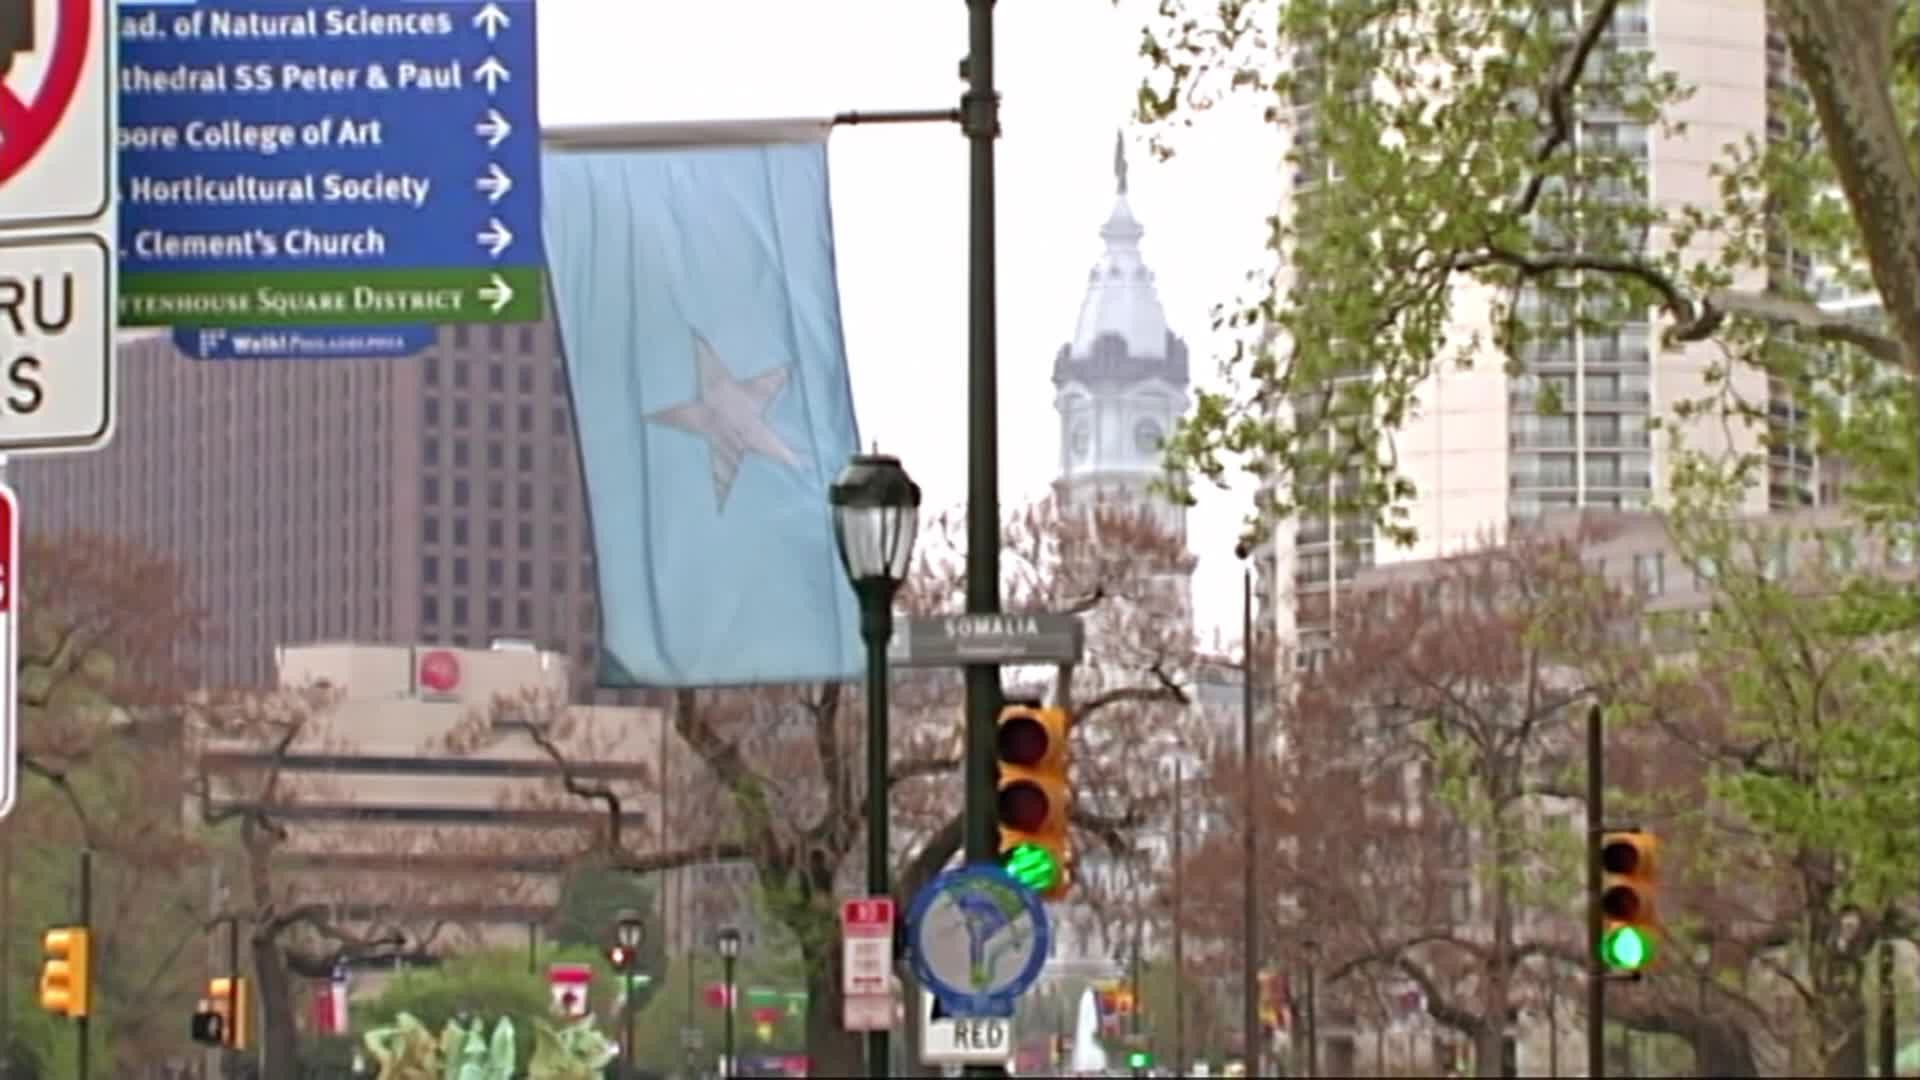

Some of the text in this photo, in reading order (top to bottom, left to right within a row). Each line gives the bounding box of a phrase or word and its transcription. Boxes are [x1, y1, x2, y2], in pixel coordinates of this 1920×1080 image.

[173, 9, 204, 37] of
[210, 9, 317, 36] Natural
[325, 8, 452, 35] Sciences
[121, 60, 461, 92] thedral SS Peter & Paul
[186, 120, 295, 154] College
[302, 118, 331, 145] of
[338, 119, 382, 145] Art
[131, 174, 314, 203] Horticultural
[323, 173, 429, 205] Society
[136, 228, 385, 257] Clement's Church
[354, 287, 463, 311] DISTRICT
[0, 355, 44, 416] S
[944, 615, 1040, 638] SOMALIA
[953, 1018, 1005, 1050] RED
